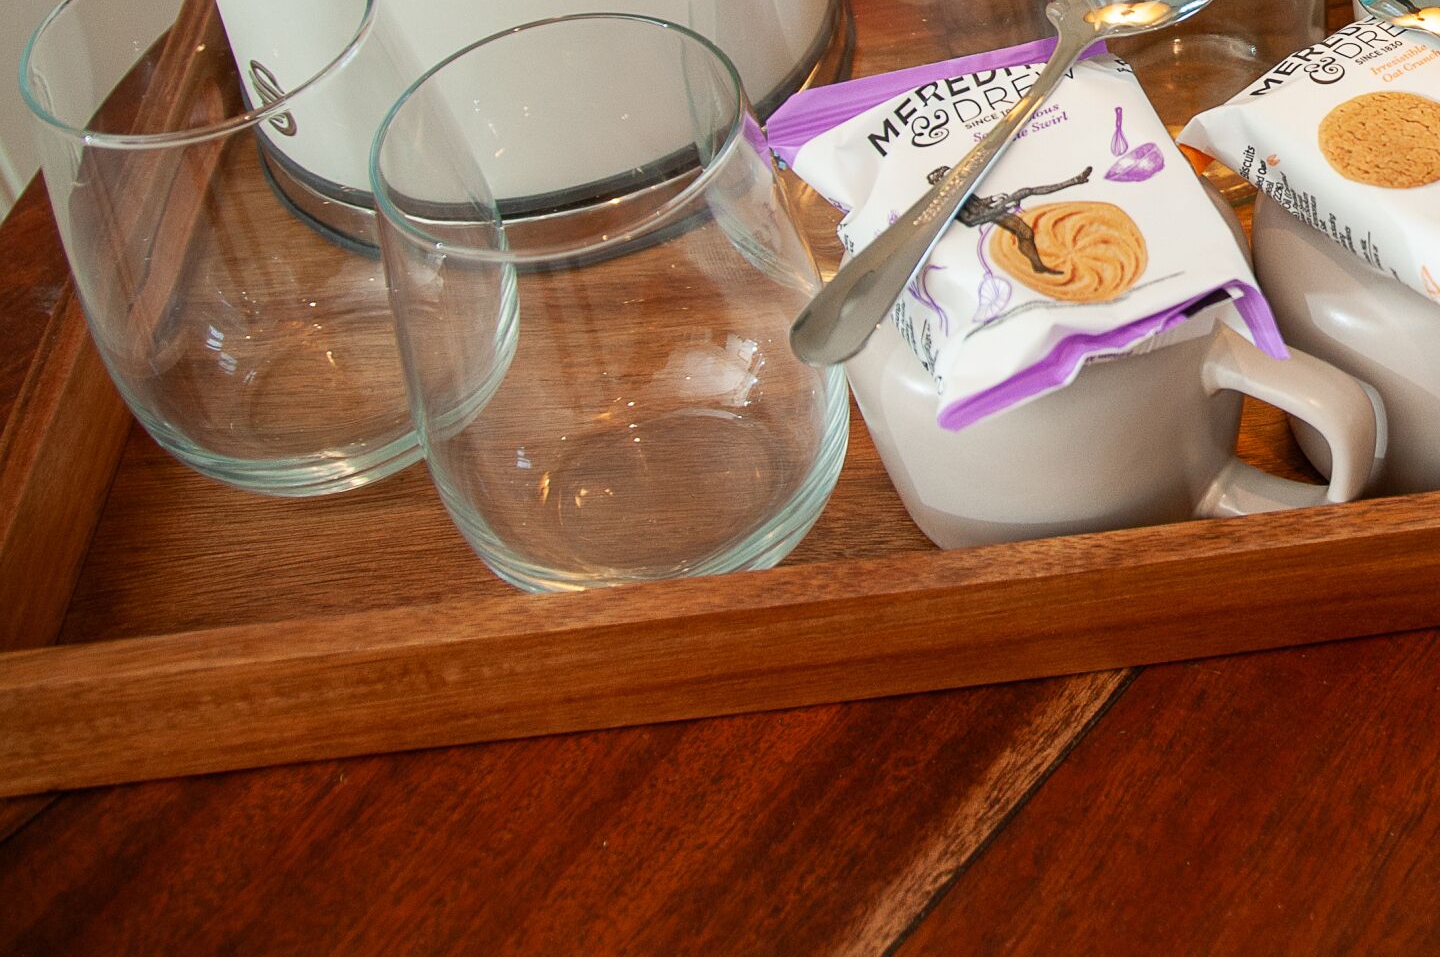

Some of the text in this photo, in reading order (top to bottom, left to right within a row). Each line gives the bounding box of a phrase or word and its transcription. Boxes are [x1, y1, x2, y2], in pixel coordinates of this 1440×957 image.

[1250, 16, 1377, 95] MERED
[1303, 21, 1408, 84] & DRE
[1355, 40, 1403, 65] SINCE 1830
[1370, 43, 1428, 76] Irresistible
[1382, 67, 1404, 83] Oat
[867, 63, 1033, 157] MERED
[965, 114, 1000, 130] SINCE
[1031, 111, 1069, 133] Swirl
[911, 108, 950, 148] &
